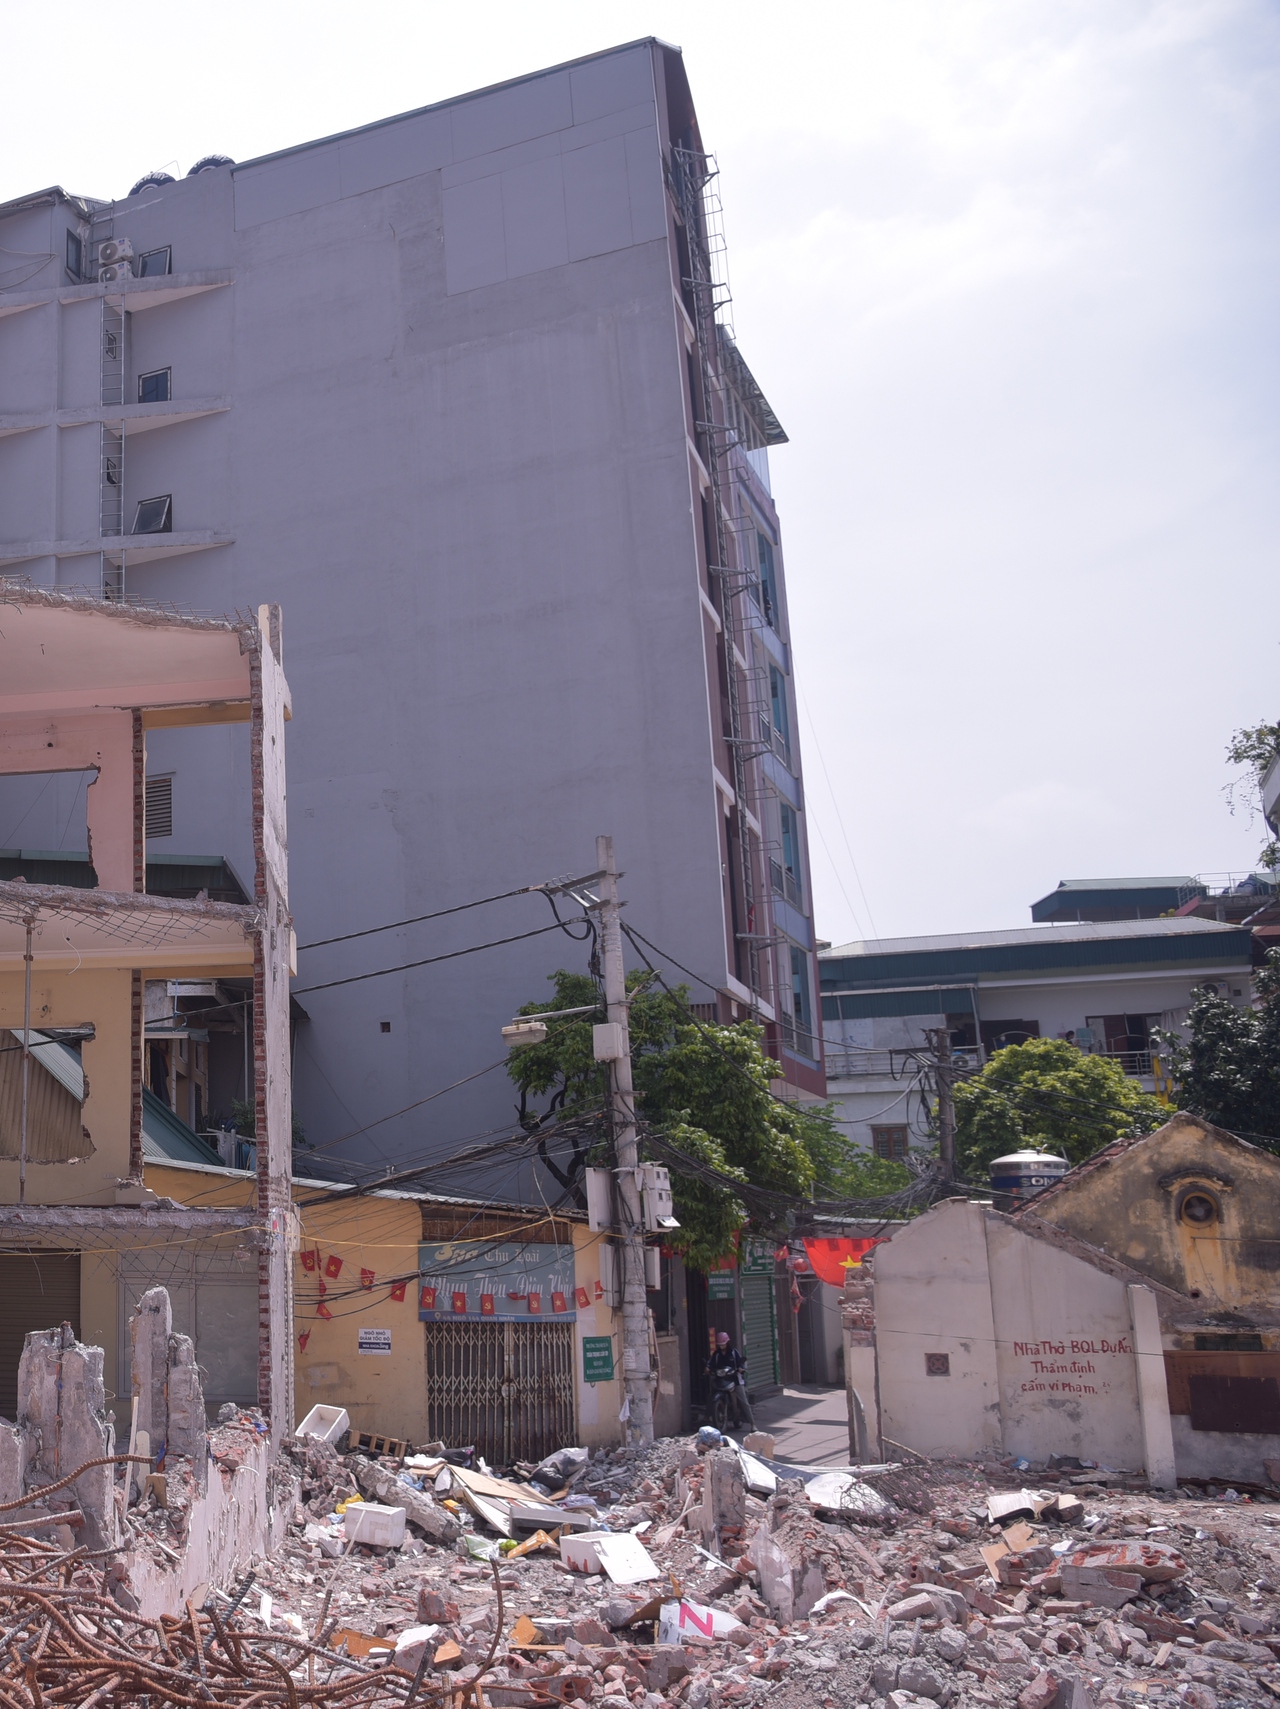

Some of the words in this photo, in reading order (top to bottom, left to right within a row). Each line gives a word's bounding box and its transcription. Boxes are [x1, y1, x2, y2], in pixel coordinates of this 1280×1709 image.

[434, 1244, 478, 1266] Spa
[1071, 1340, 1100, 1354] BQL
[1031, 1359, 1068, 1374] Thẩm
[1070, 1359, 1096, 1378] định
[1021, 1377, 1046, 1392] cấm
